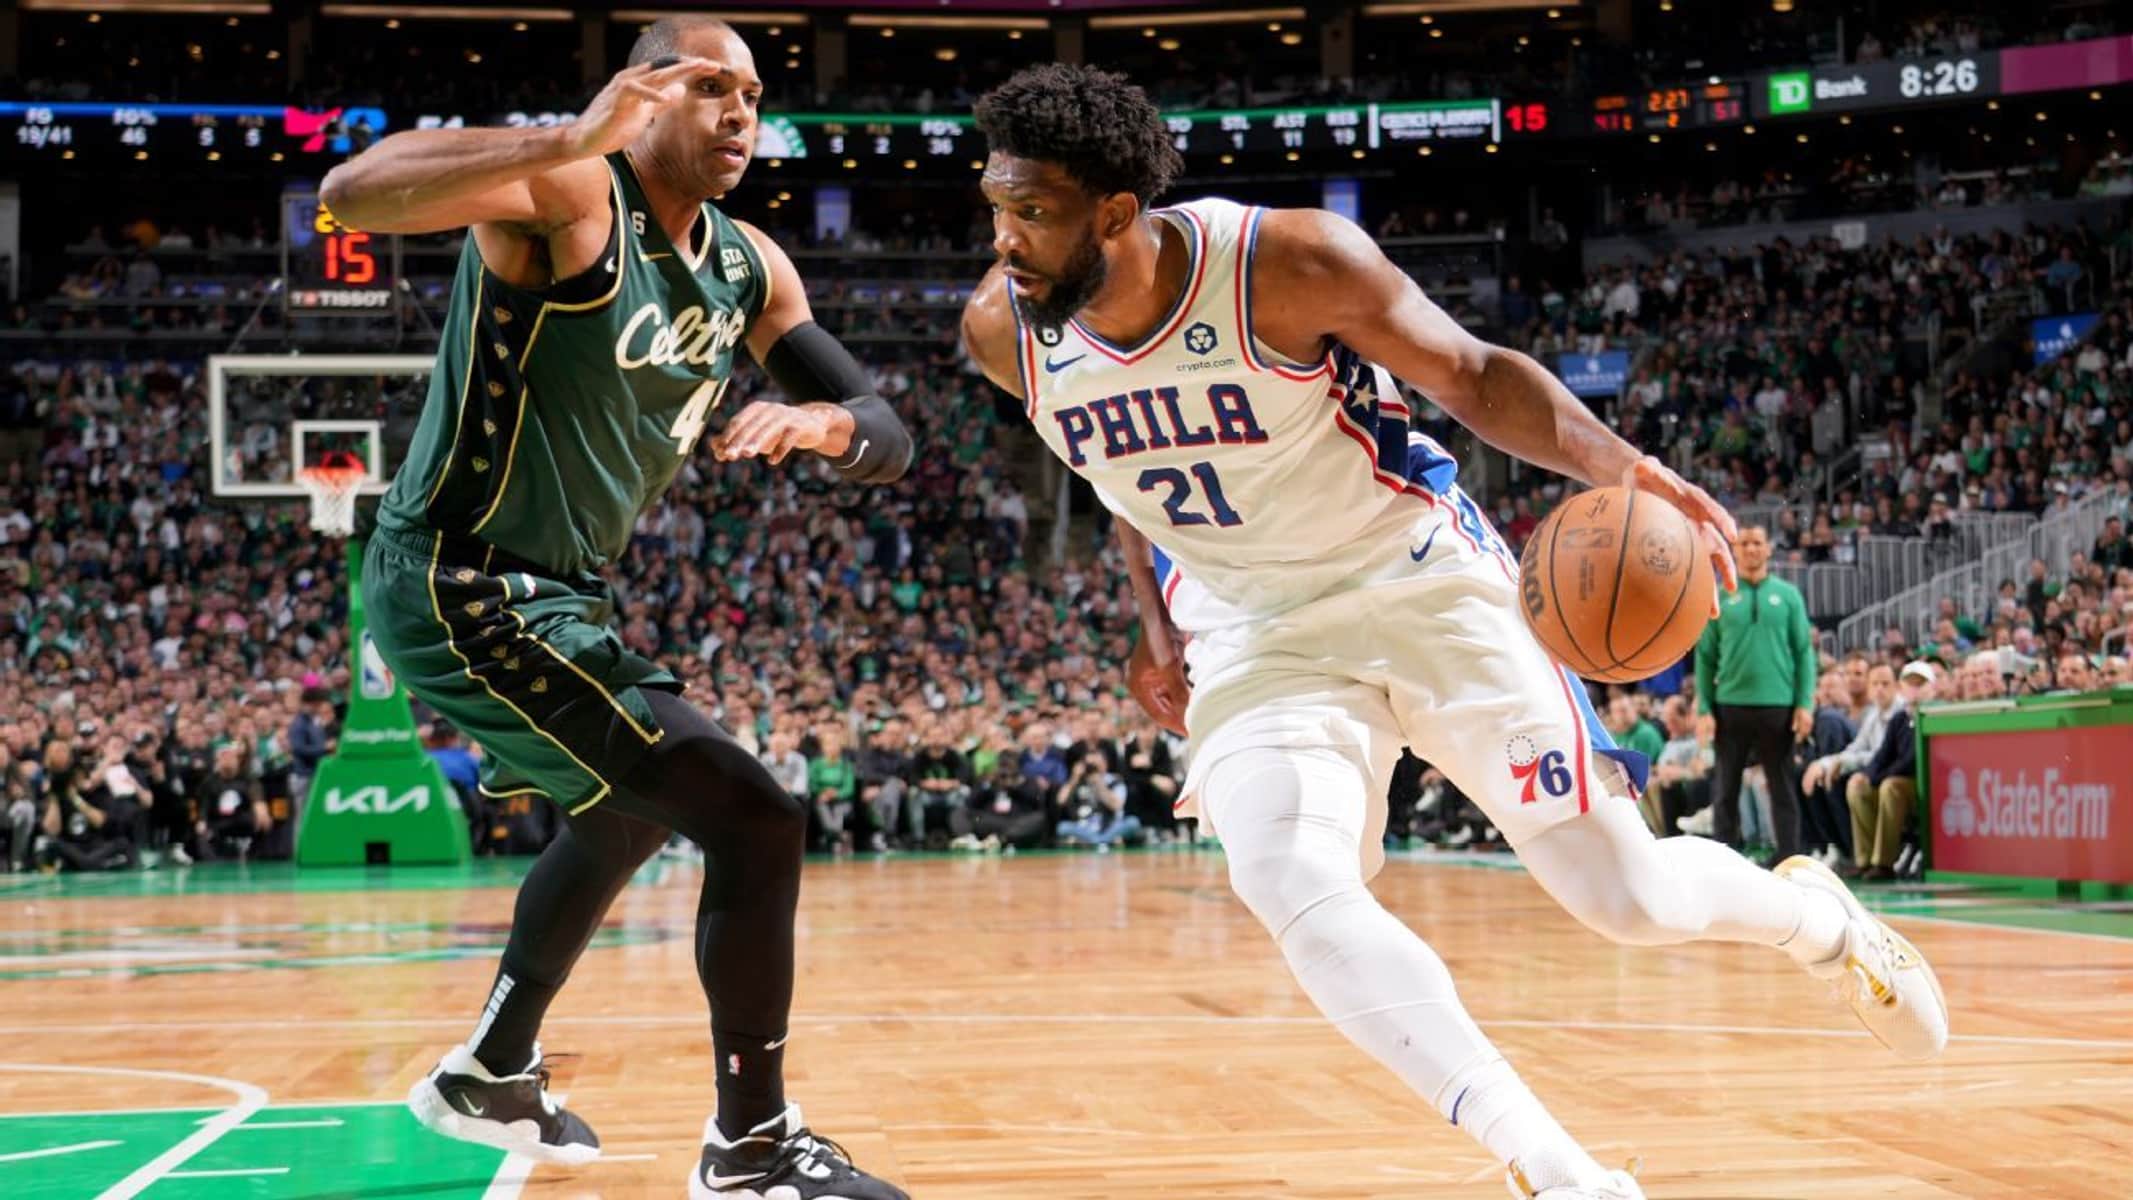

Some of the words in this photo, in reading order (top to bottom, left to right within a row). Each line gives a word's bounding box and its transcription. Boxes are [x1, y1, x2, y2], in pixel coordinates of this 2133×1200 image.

[1776, 80, 1807, 106] TD
[1815, 74, 1867, 99] Bank
[1900, 59, 1979, 98] 8:26
[26, 107, 53, 125] FG
[1274, 111, 1307, 128] AST
[1505, 103, 1547, 131] 15
[16, 125, 72, 149] 19/41
[631, 210, 647, 236] 6
[324, 233, 376, 284] 15
[1175, 356, 1237, 373] crypto.com
[1053, 383, 1270, 469] PHILA
[1136, 460, 1245, 529] 21
[1508, 749, 1573, 805] 76
